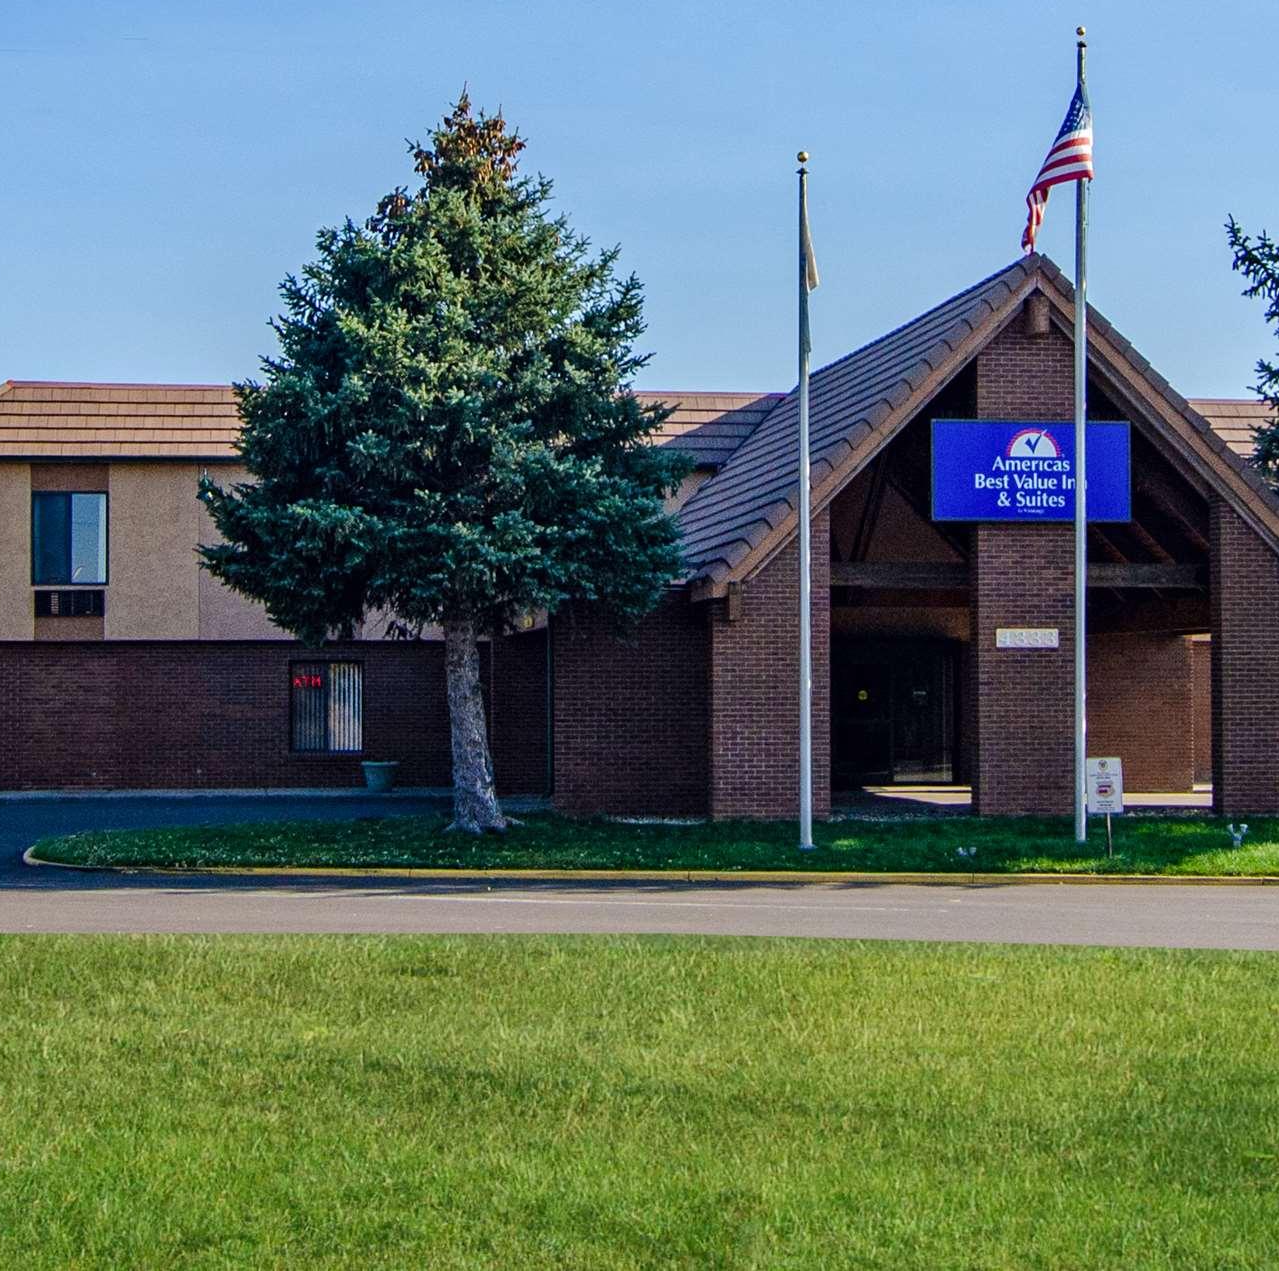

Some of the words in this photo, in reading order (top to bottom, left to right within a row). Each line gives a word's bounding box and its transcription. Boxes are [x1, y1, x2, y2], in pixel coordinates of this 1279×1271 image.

[992, 455, 1070, 472] Americas
[974, 473, 1010, 489] Best
[1013, 472, 1058, 489] Value
[1062, 474, 1087, 490] In
[997, 491, 1011, 507] &
[1016, 490, 1066, 507] Suites
[293, 674, 321, 689] ATM
